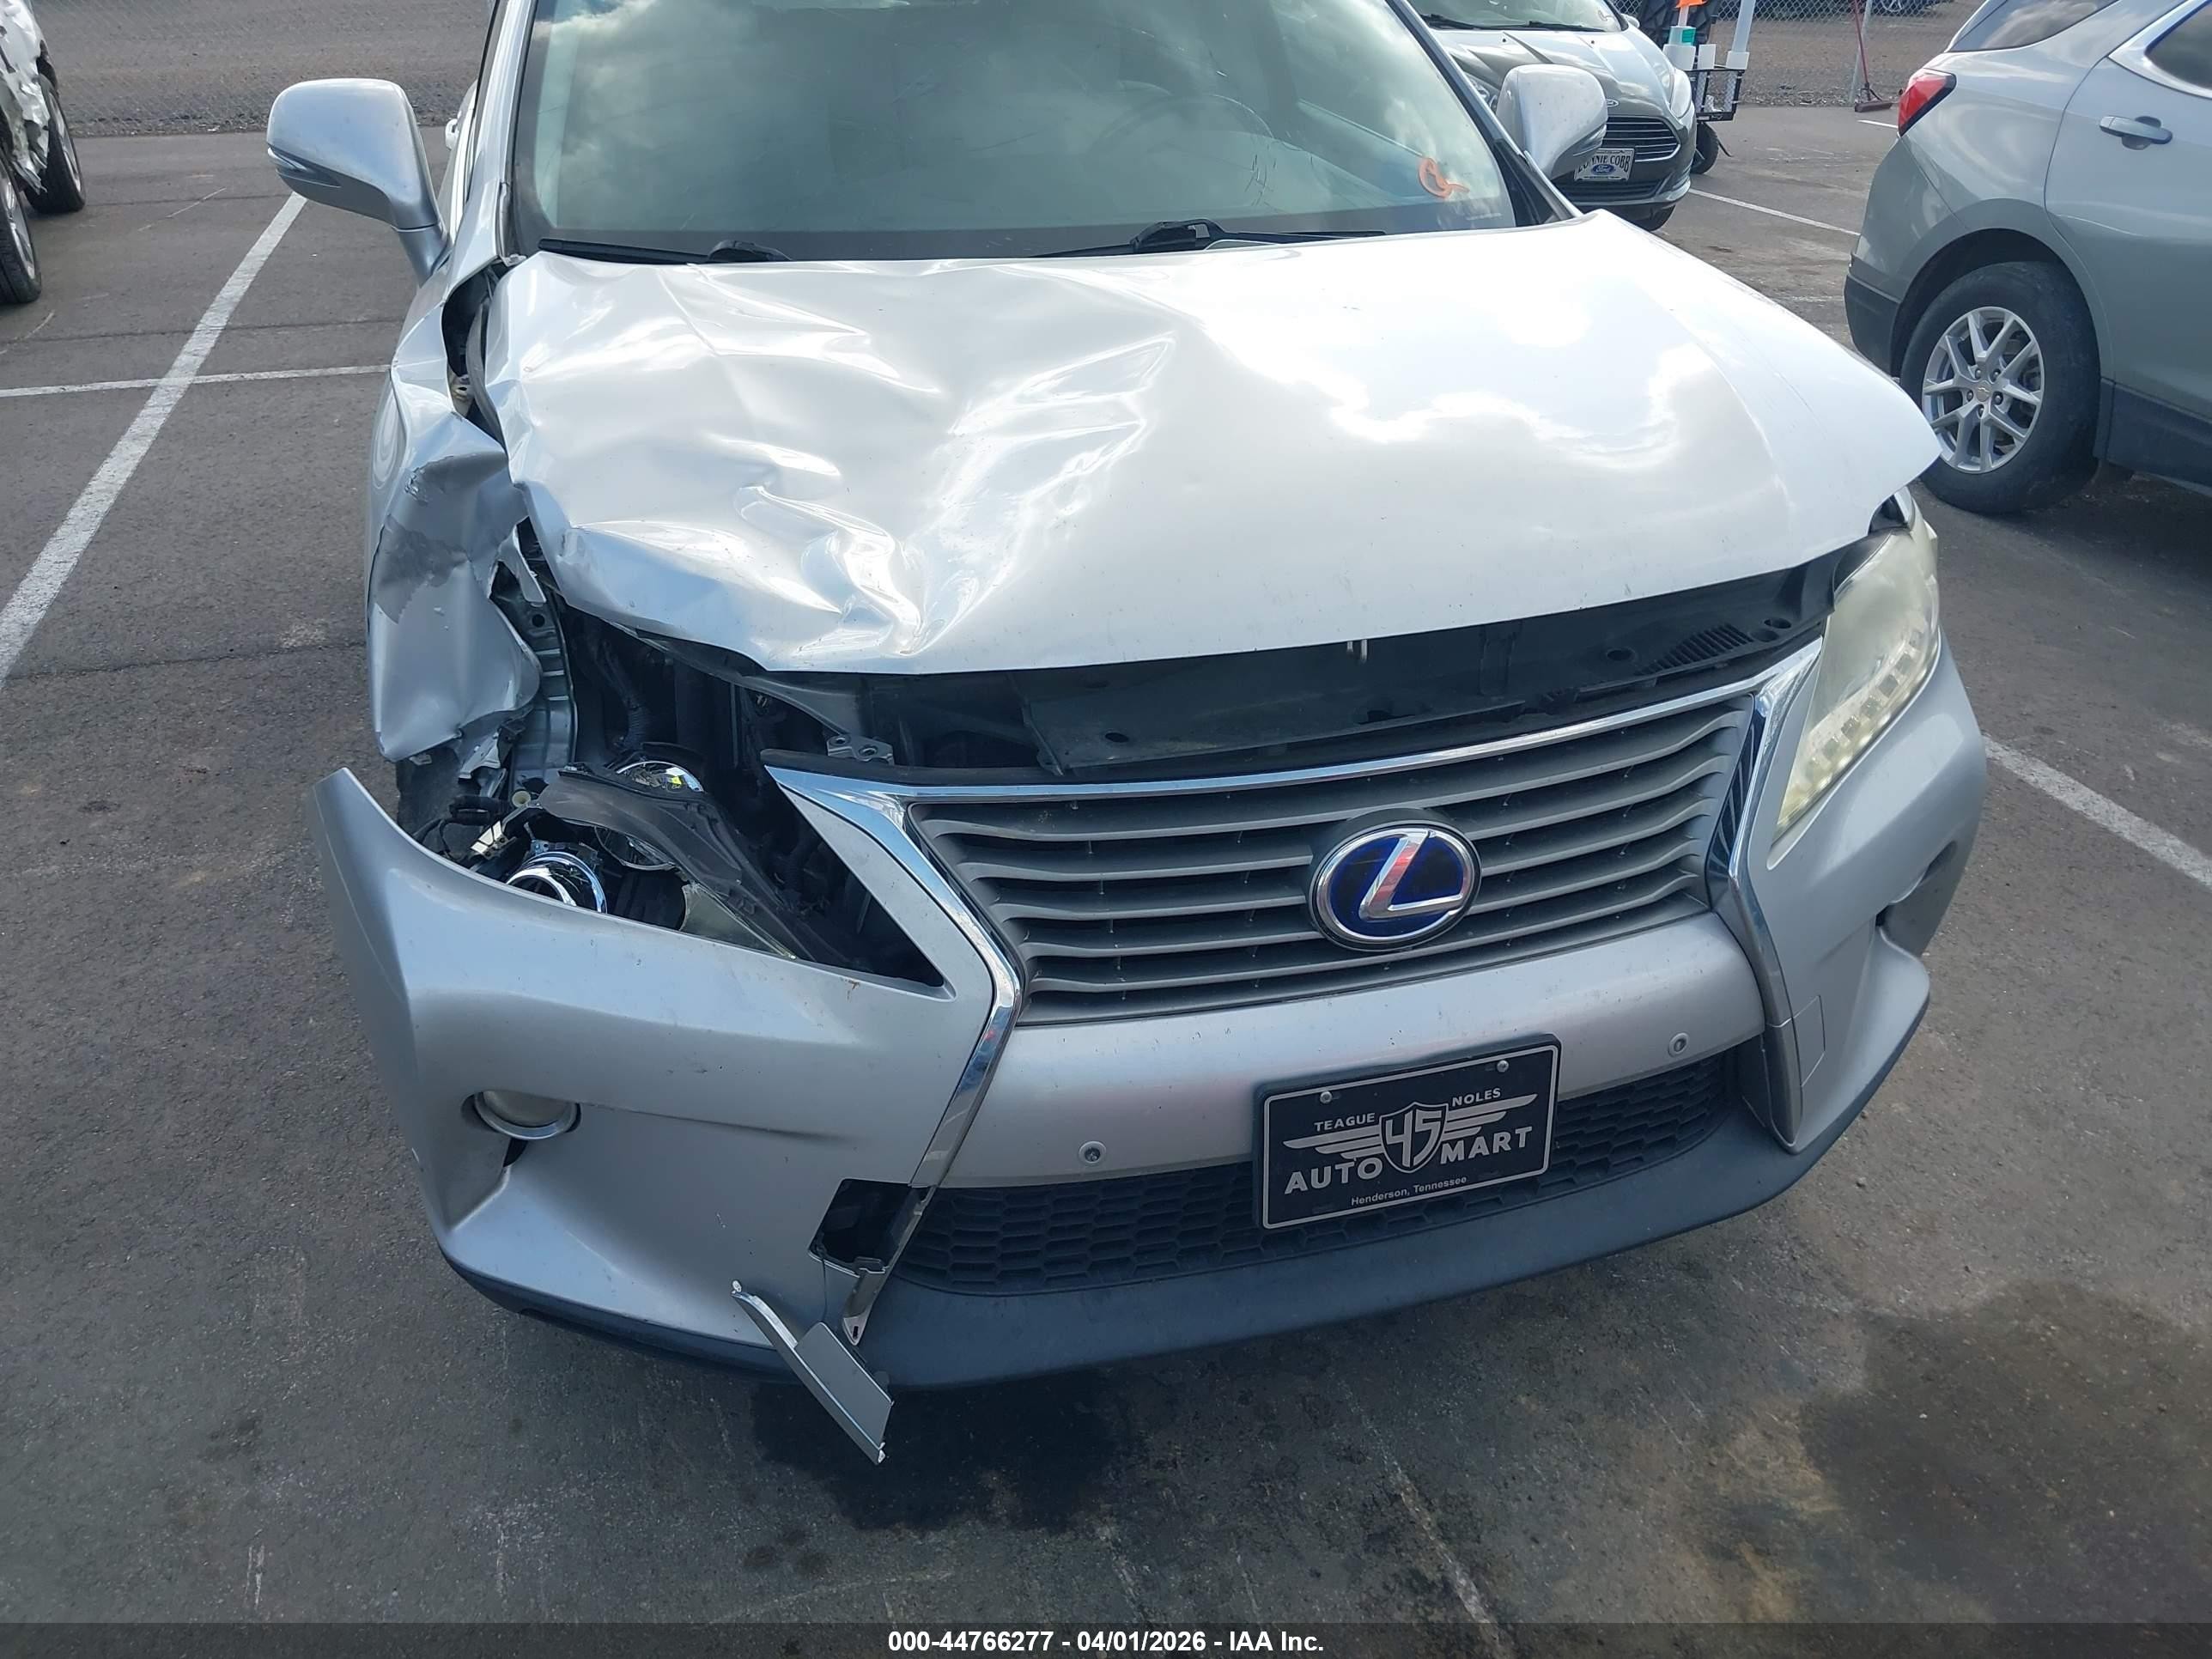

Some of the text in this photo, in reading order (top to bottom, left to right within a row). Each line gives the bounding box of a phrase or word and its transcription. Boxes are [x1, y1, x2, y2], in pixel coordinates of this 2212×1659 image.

[1610, 155, 1631, 173] COBB
[1314, 1087, 1501, 1133] TEAGUE NOLES
[1284, 1126, 1533, 1194] AUTO MART
[1351, 1176, 1468, 1206] Henderson, Tennessee
